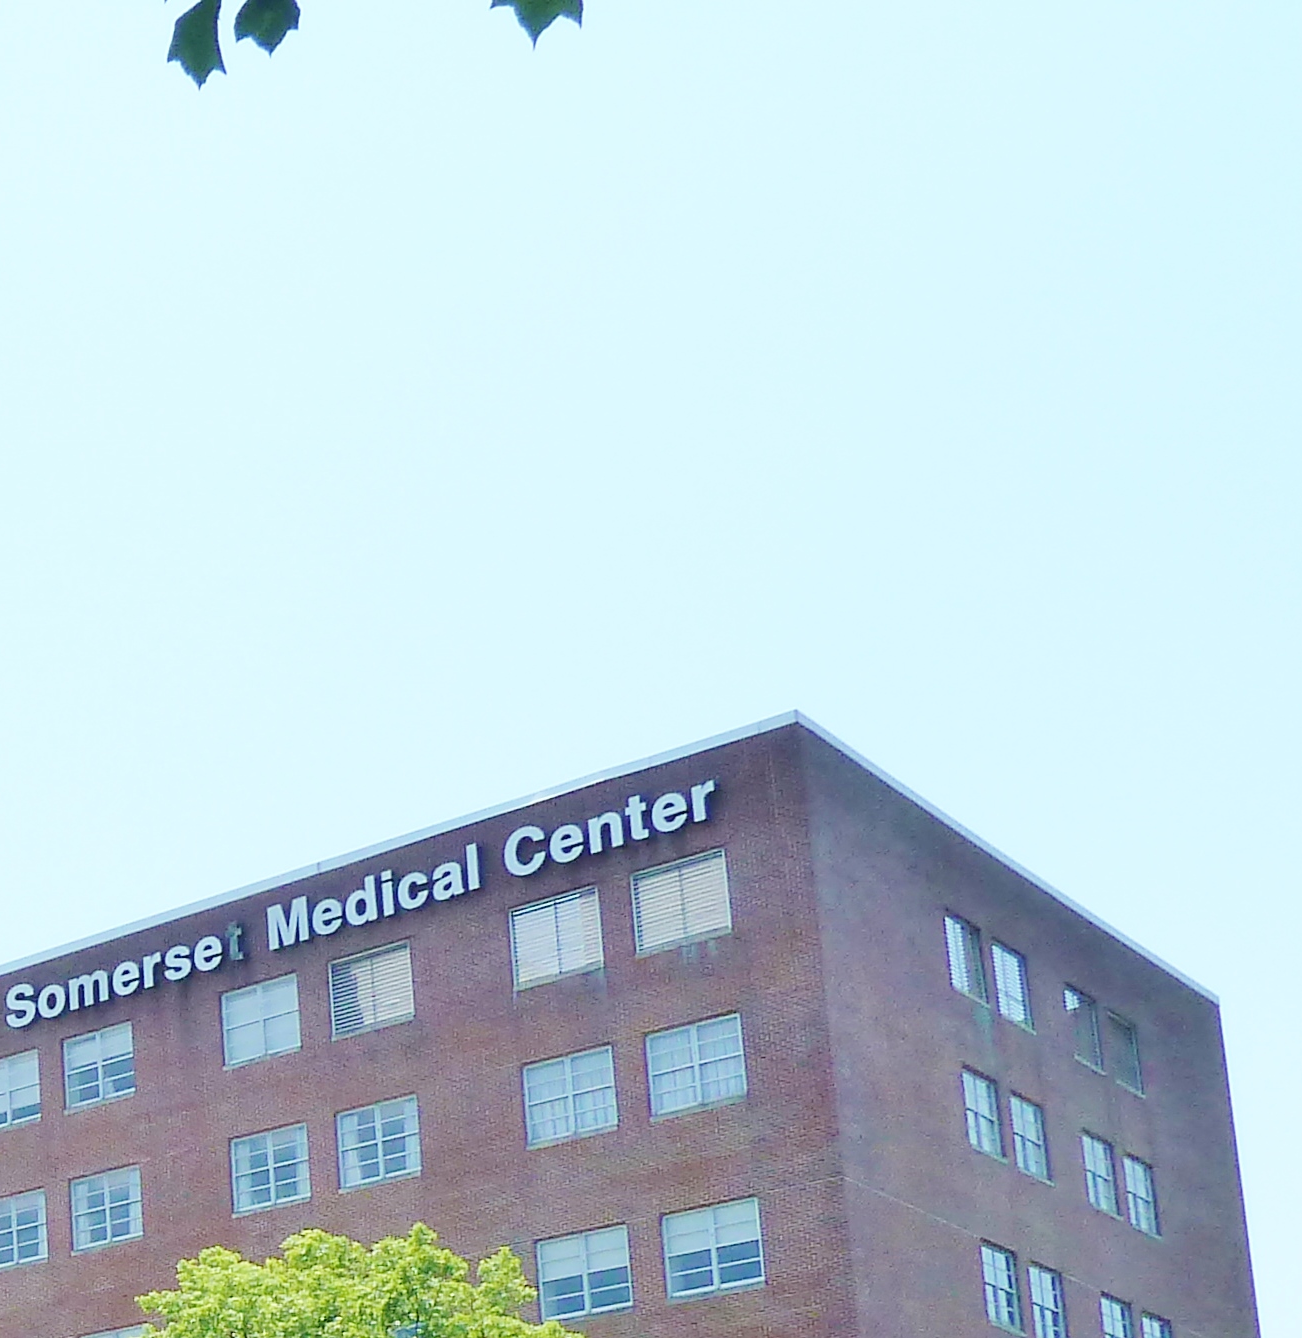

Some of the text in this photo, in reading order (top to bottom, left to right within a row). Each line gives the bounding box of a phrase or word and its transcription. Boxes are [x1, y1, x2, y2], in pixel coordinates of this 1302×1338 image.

[4, 778, 718, 1030] Somerset Medical Center
